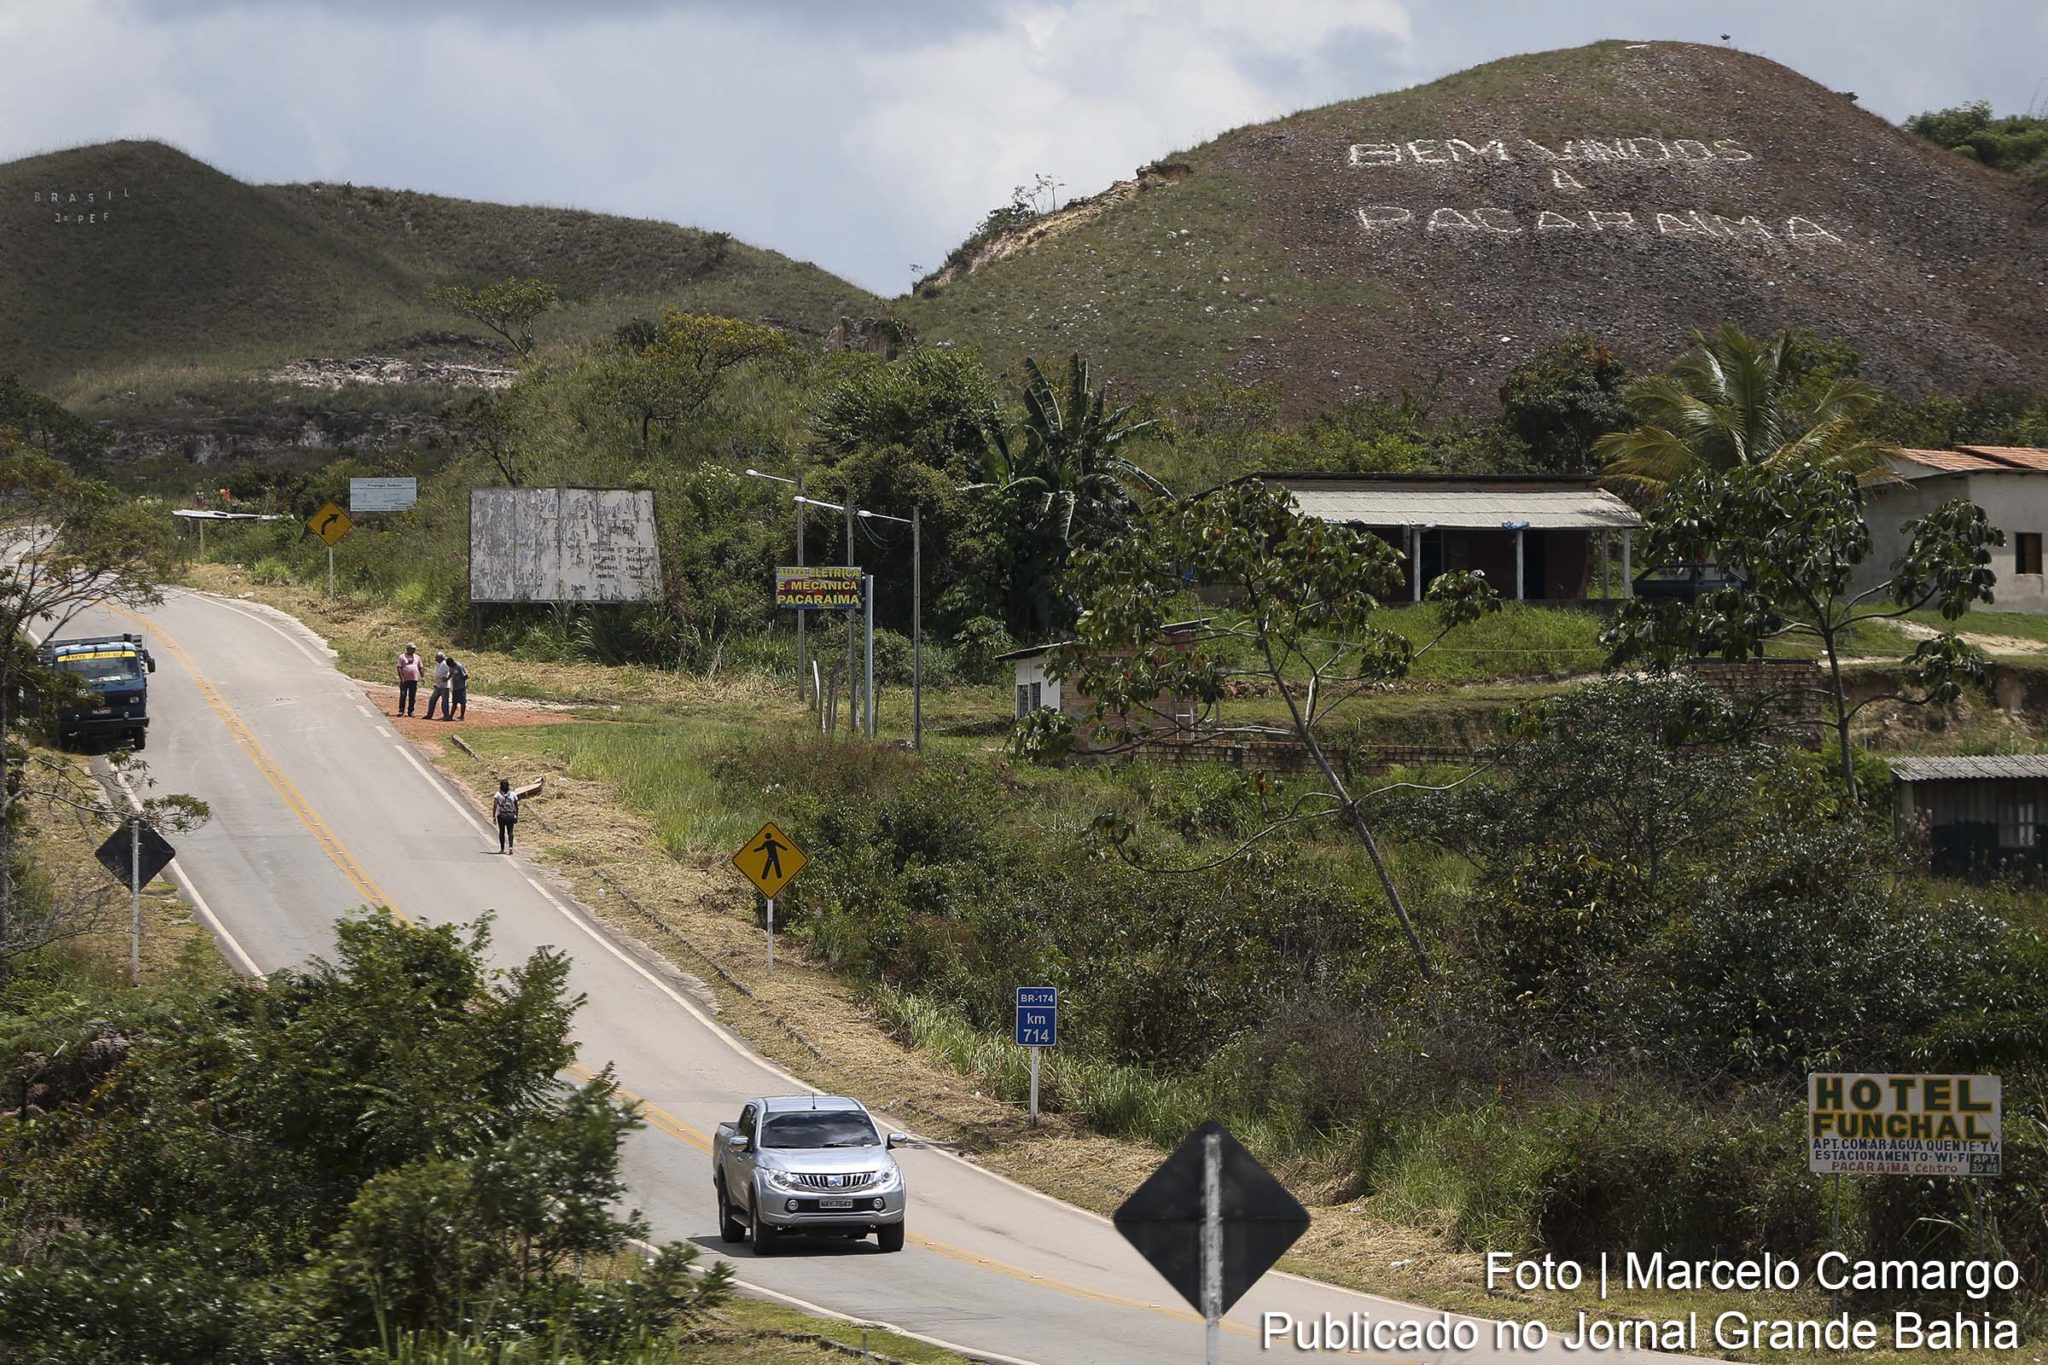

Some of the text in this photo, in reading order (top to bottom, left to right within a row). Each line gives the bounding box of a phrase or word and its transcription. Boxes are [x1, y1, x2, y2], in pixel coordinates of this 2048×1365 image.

[1350, 136, 1754, 166] BEM VINDOS
[1552, 168, 1586, 189] A
[34, 187, 128, 202] BRASIL
[78, 211, 110, 224] PEF
[1359, 204, 1843, 243] PACARAIMA
[791, 581, 857, 590] MECANICA
[1020, 994, 1054, 1003] BR-174
[1027, 1012, 1046, 1025] km
[1023, 1028, 1049, 1042] 714
[1815, 1076, 1994, 1113] HOTEL
[1812, 1111, 1992, 1141] FUNCHAL
[1815, 1150, 1970, 1163] ESTACIONAMENTO WI-FI
